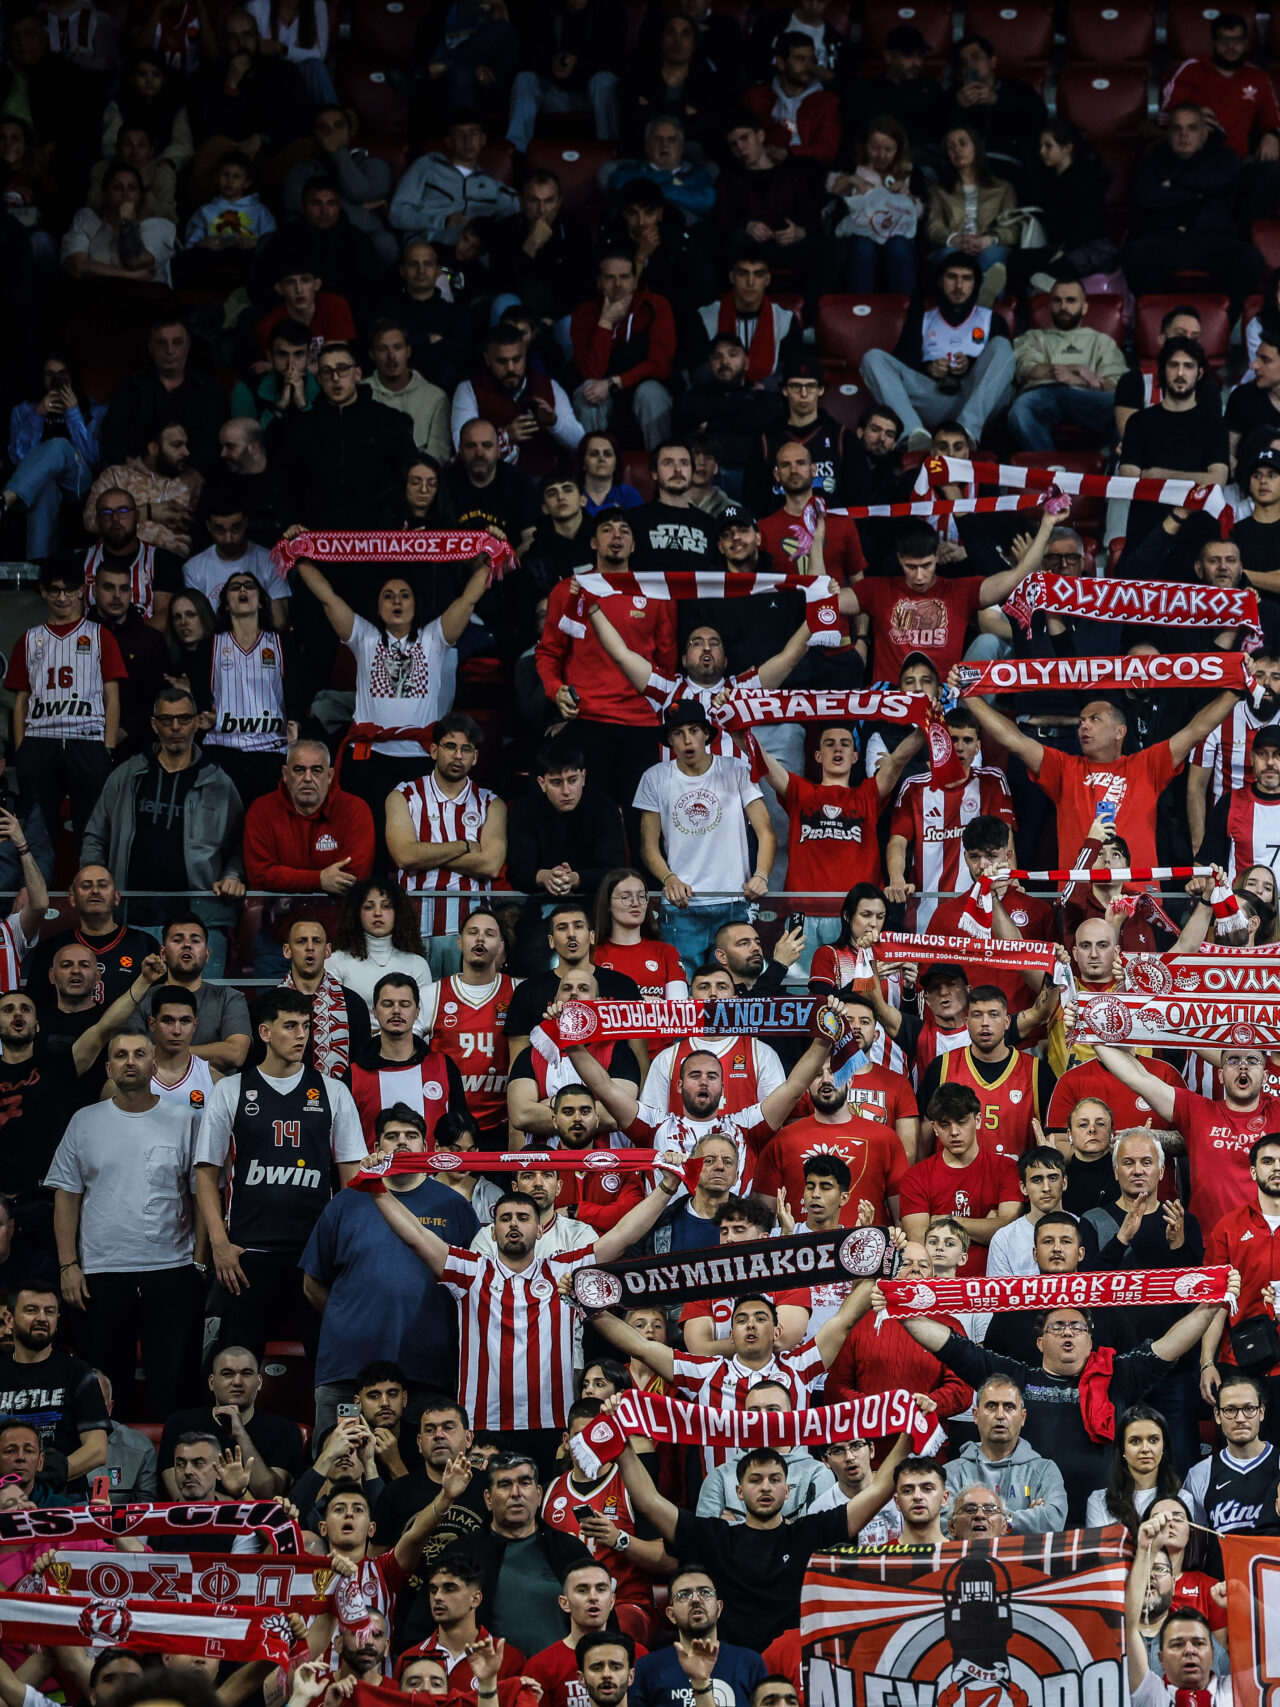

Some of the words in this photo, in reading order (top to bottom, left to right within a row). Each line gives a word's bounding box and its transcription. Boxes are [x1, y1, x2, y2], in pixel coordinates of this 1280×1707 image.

[316, 537, 440, 554] ΟΛΥΜΠΙΑΚΟΣ
[445, 538, 474, 553] FC
[656, 524, 705, 541] STAR
[46, 666, 73, 689] 16
[992, 656, 1224, 688] OLYMPIACOS
[32, 693, 92, 719] bwin
[711, 691, 914, 729] PIRAEUS
[220, 711, 283, 735] bwin
[799, 825, 862, 844] PIRAEUS
[948, 936, 971, 949] CFP
[984, 938, 1049, 955] LIVERPOOL
[598, 1003, 699, 1030] OLYMPIACOS
[458, 1031, 495, 1059] 94
[461, 1062, 508, 1093] win
[271, 1119, 302, 1148] 14
[244, 1158, 322, 1189] bwin
[625, 1243, 836, 1294] ΟΛΥΜΠΙΑΚΟΣ
[965, 1273, 1145, 1298] ΟΛΥΜΠΙΑΚΟΣ
[969, 1297, 999, 1308] 1925
[1008, 1293, 1102, 1306] ΘΡΥΛΟΣ
[1112, 1291, 1141, 1301] 1925
[618, 1388, 912, 1438] OLYMPIACOS
[86, 1562, 297, 1607] ΟΣΦΠ
[966, 1662, 997, 1680] GATE
